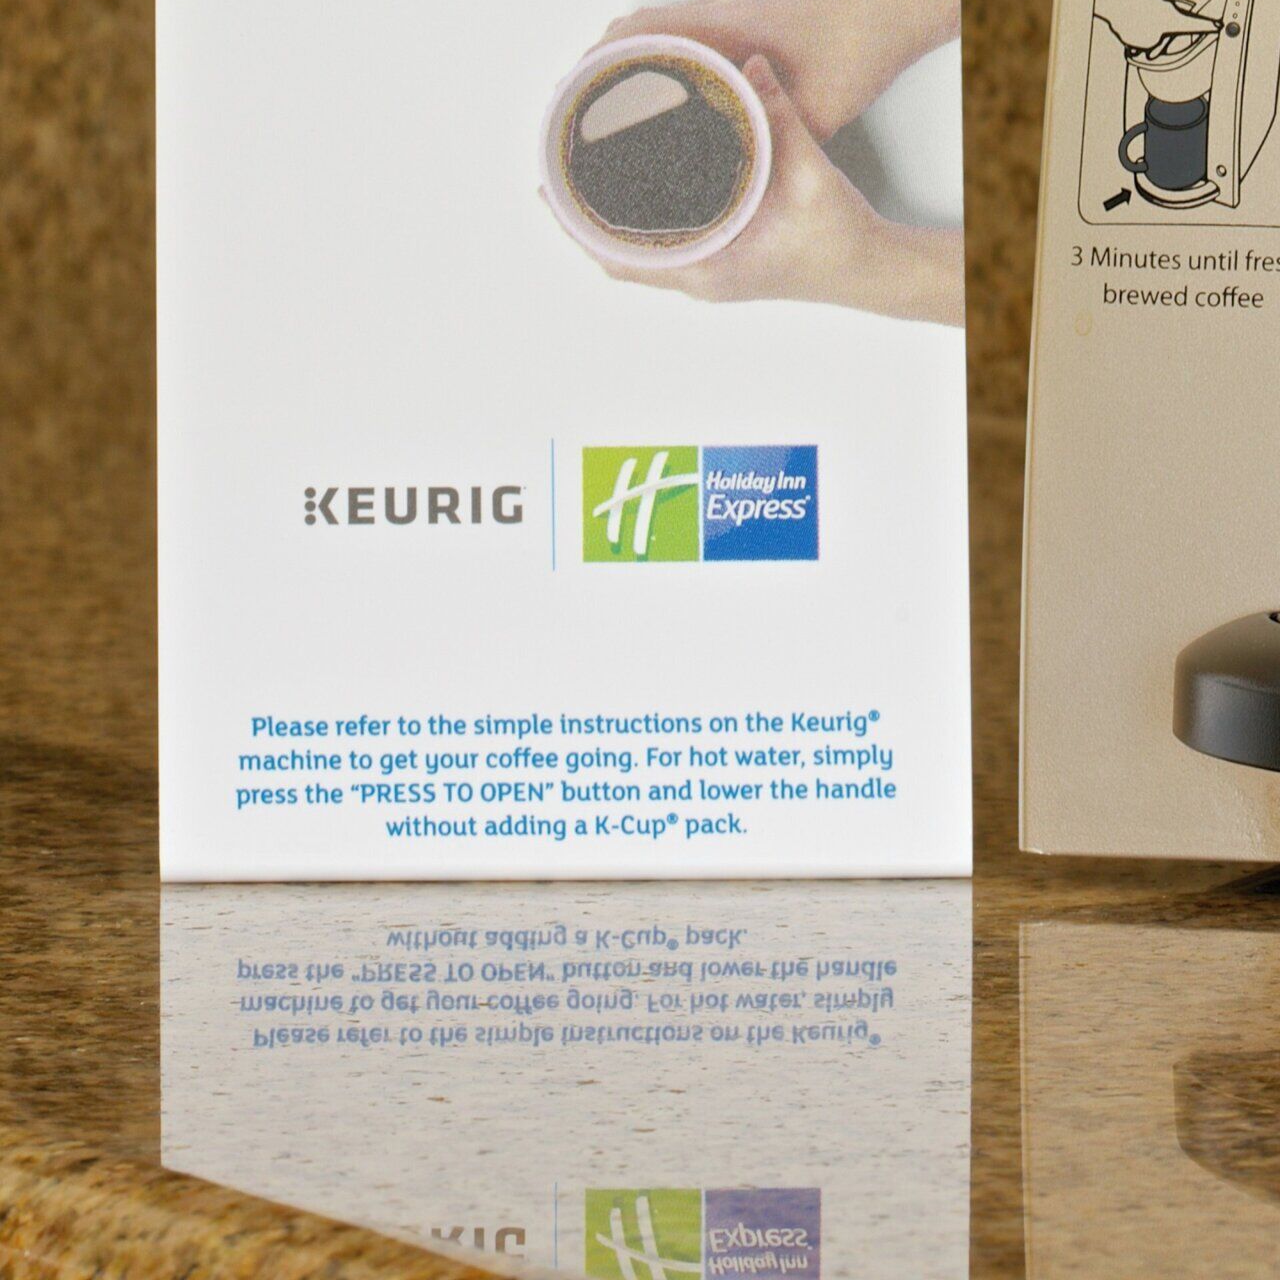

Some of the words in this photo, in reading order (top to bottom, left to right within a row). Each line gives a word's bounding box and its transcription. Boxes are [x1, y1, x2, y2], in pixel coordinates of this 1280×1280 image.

[1072, 246, 1082, 266] 3
[1091, 247, 1180, 269] Minutes
[1189, 250, 1237, 270] until
[1104, 283, 1187, 306] brewed
[1195, 286, 1263, 308] coffee
[707, 471, 773, 493] Holiday
[776, 472, 806, 489] Inn
[305, 486, 522, 525] KEURIG
[252, 717, 328, 736] Please
[336, 715, 391, 736] refer
[397, 718, 421, 736] to
[428, 716, 466, 735] the
[474, 714, 552, 739] simple
[560, 715, 702, 736] instructions
[709, 716, 738, 733] on
[745, 714, 784, 733] the
[239, 751, 341, 772] machine
[348, 752, 372, 770] to
[380, 752, 416, 776] get
[424, 753, 478, 775] your
[486, 747, 558, 768] coffee
[565, 750, 637, 774] going.
[646, 747, 680, 767] For
[688, 748, 727, 767] hot
[735, 748, 806, 768] water,
[813, 744, 893, 772] simply
[236, 789, 297, 809] press
[305, 784, 343, 804] the
[444, 783, 474, 803] TO
[561, 781, 640, 803] button
[648, 780, 692, 801] and
[699, 780, 761, 800] lower
[770, 780, 807, 799] the
[815, 778, 896, 799] handle
[386, 817, 477, 837] without
[483, 816, 567, 842] adding
[574, 820, 587, 836] a
[685, 812, 747, 838] pack.
